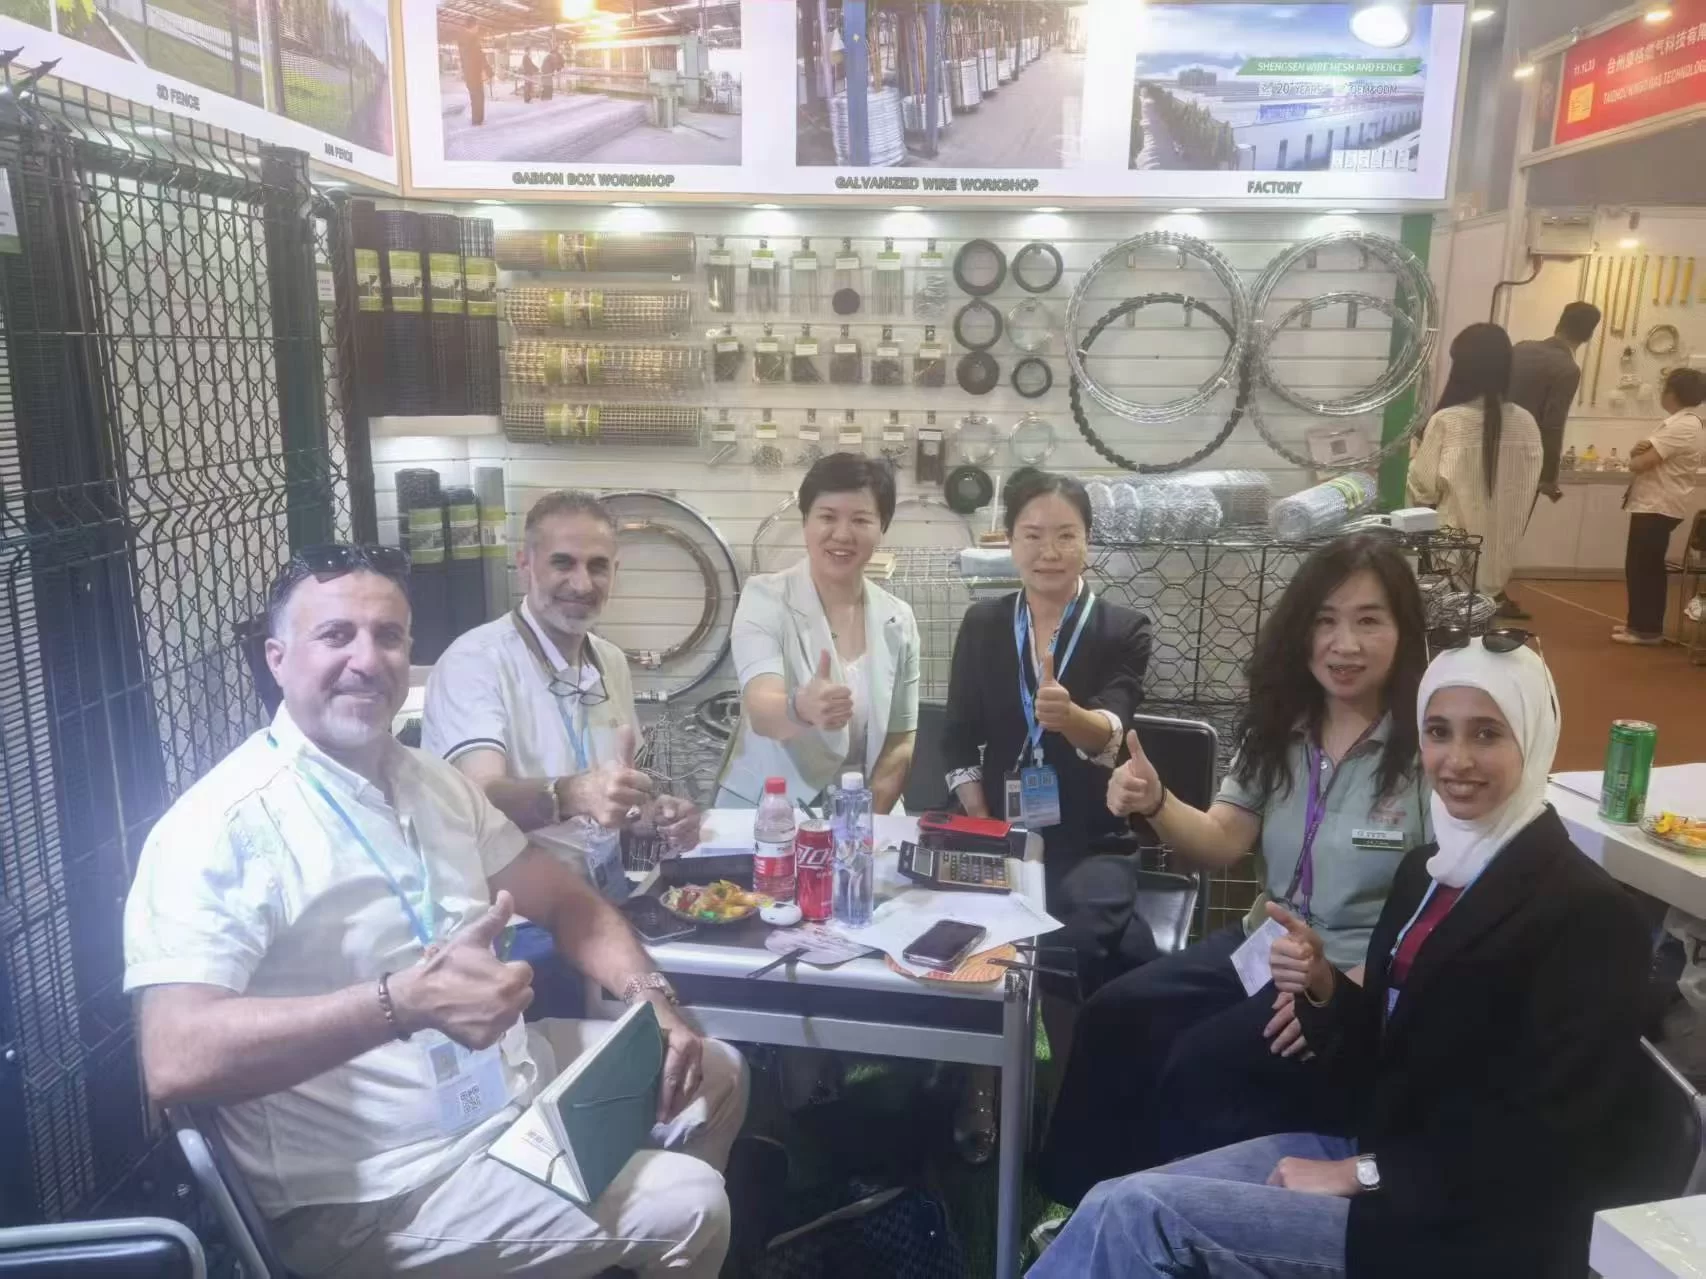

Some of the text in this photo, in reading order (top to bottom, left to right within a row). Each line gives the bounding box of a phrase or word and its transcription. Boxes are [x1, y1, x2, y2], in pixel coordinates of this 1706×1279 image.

[1354, 62, 1375, 73] AND
[1376, 62, 1405, 73] FENCE
[170, 88, 200, 111] FENCE
[512, 171, 676, 187] GABION BOX WORKSHOP
[834, 175, 1040, 192] GALVANIZED WIRE WORKSHOP
[1247, 181, 1303, 195] FACTORY
